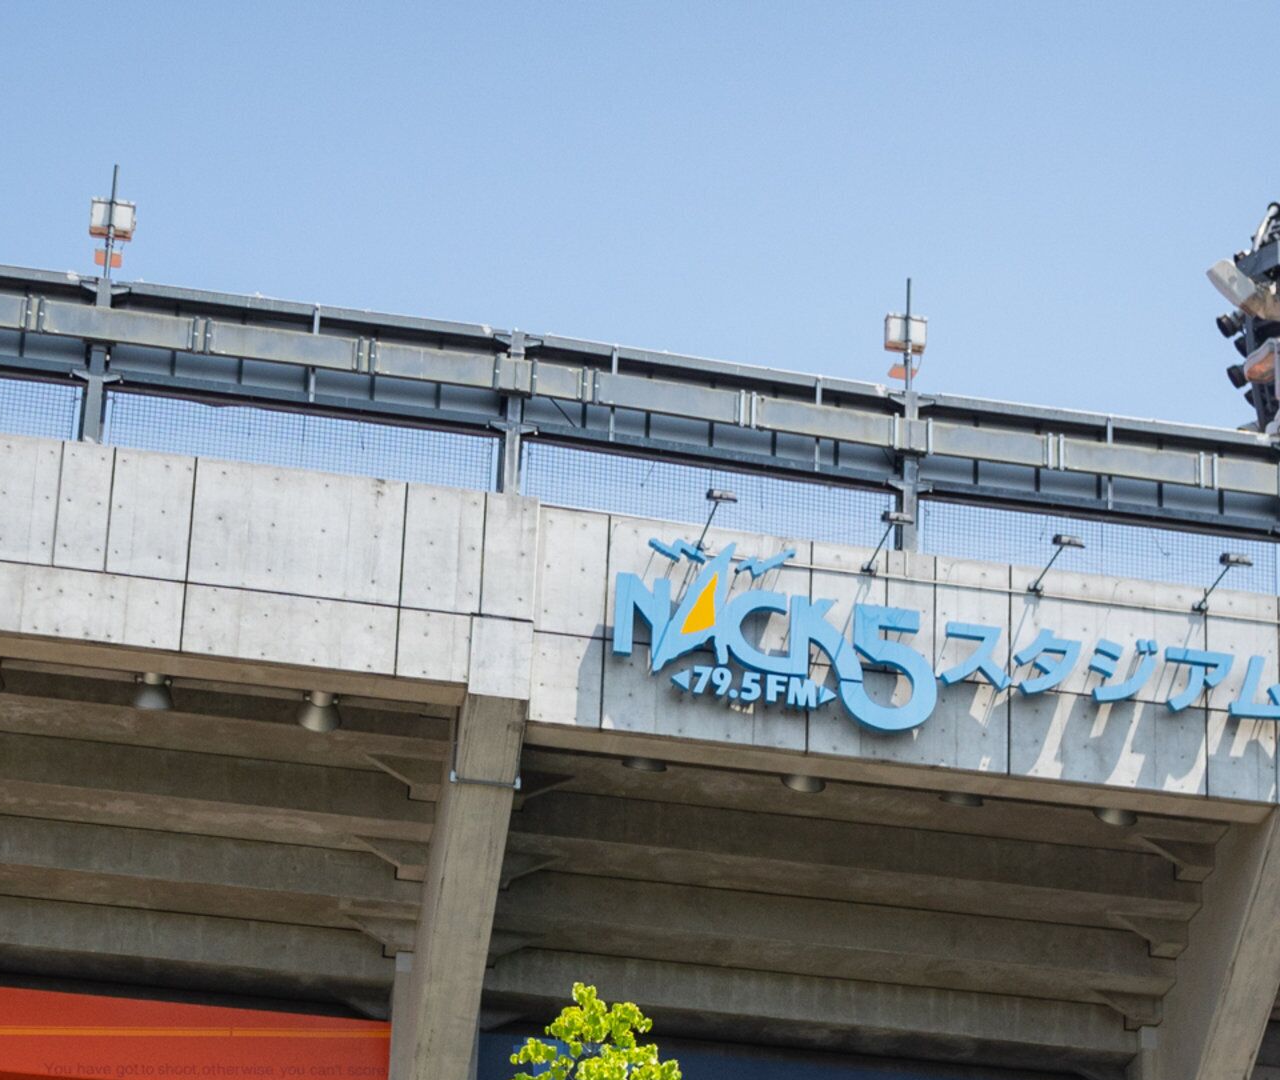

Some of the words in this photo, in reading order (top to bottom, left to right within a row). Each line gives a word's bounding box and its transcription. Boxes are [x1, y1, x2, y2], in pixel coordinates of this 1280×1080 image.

[613, 542, 937, 731] NACK5
[44, 1062, 73, 1076] You
[77, 1062, 112, 1076] have
[279, 1065, 305, 1079] you
